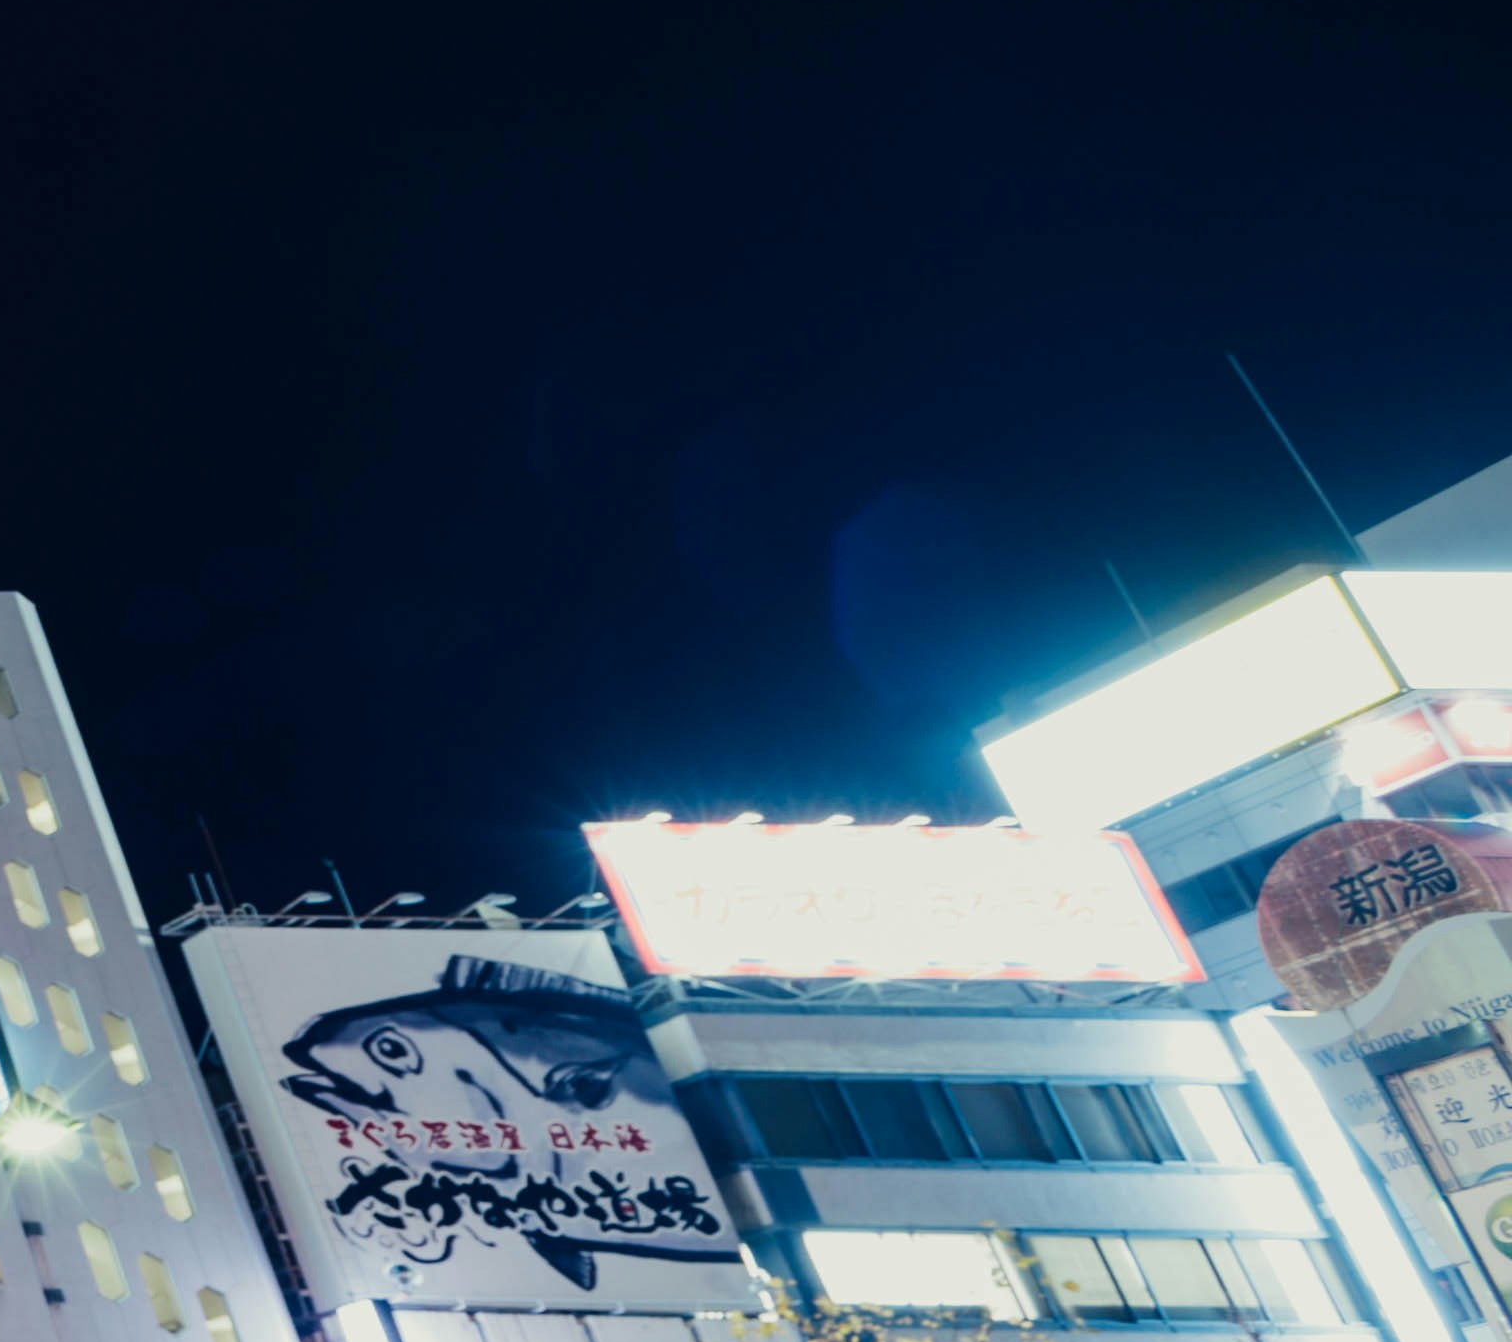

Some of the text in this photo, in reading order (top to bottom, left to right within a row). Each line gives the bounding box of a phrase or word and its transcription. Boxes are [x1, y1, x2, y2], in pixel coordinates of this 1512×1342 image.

[1330, 843, 1459, 926] 新潟
[1313, 1022, 1415, 1067] Welcome
[1421, 1014, 1448, 1039] to
[325, 1116, 654, 1154] まぐろ居酒屋 日本海
[325, 1159, 722, 1237] さかなや道場
